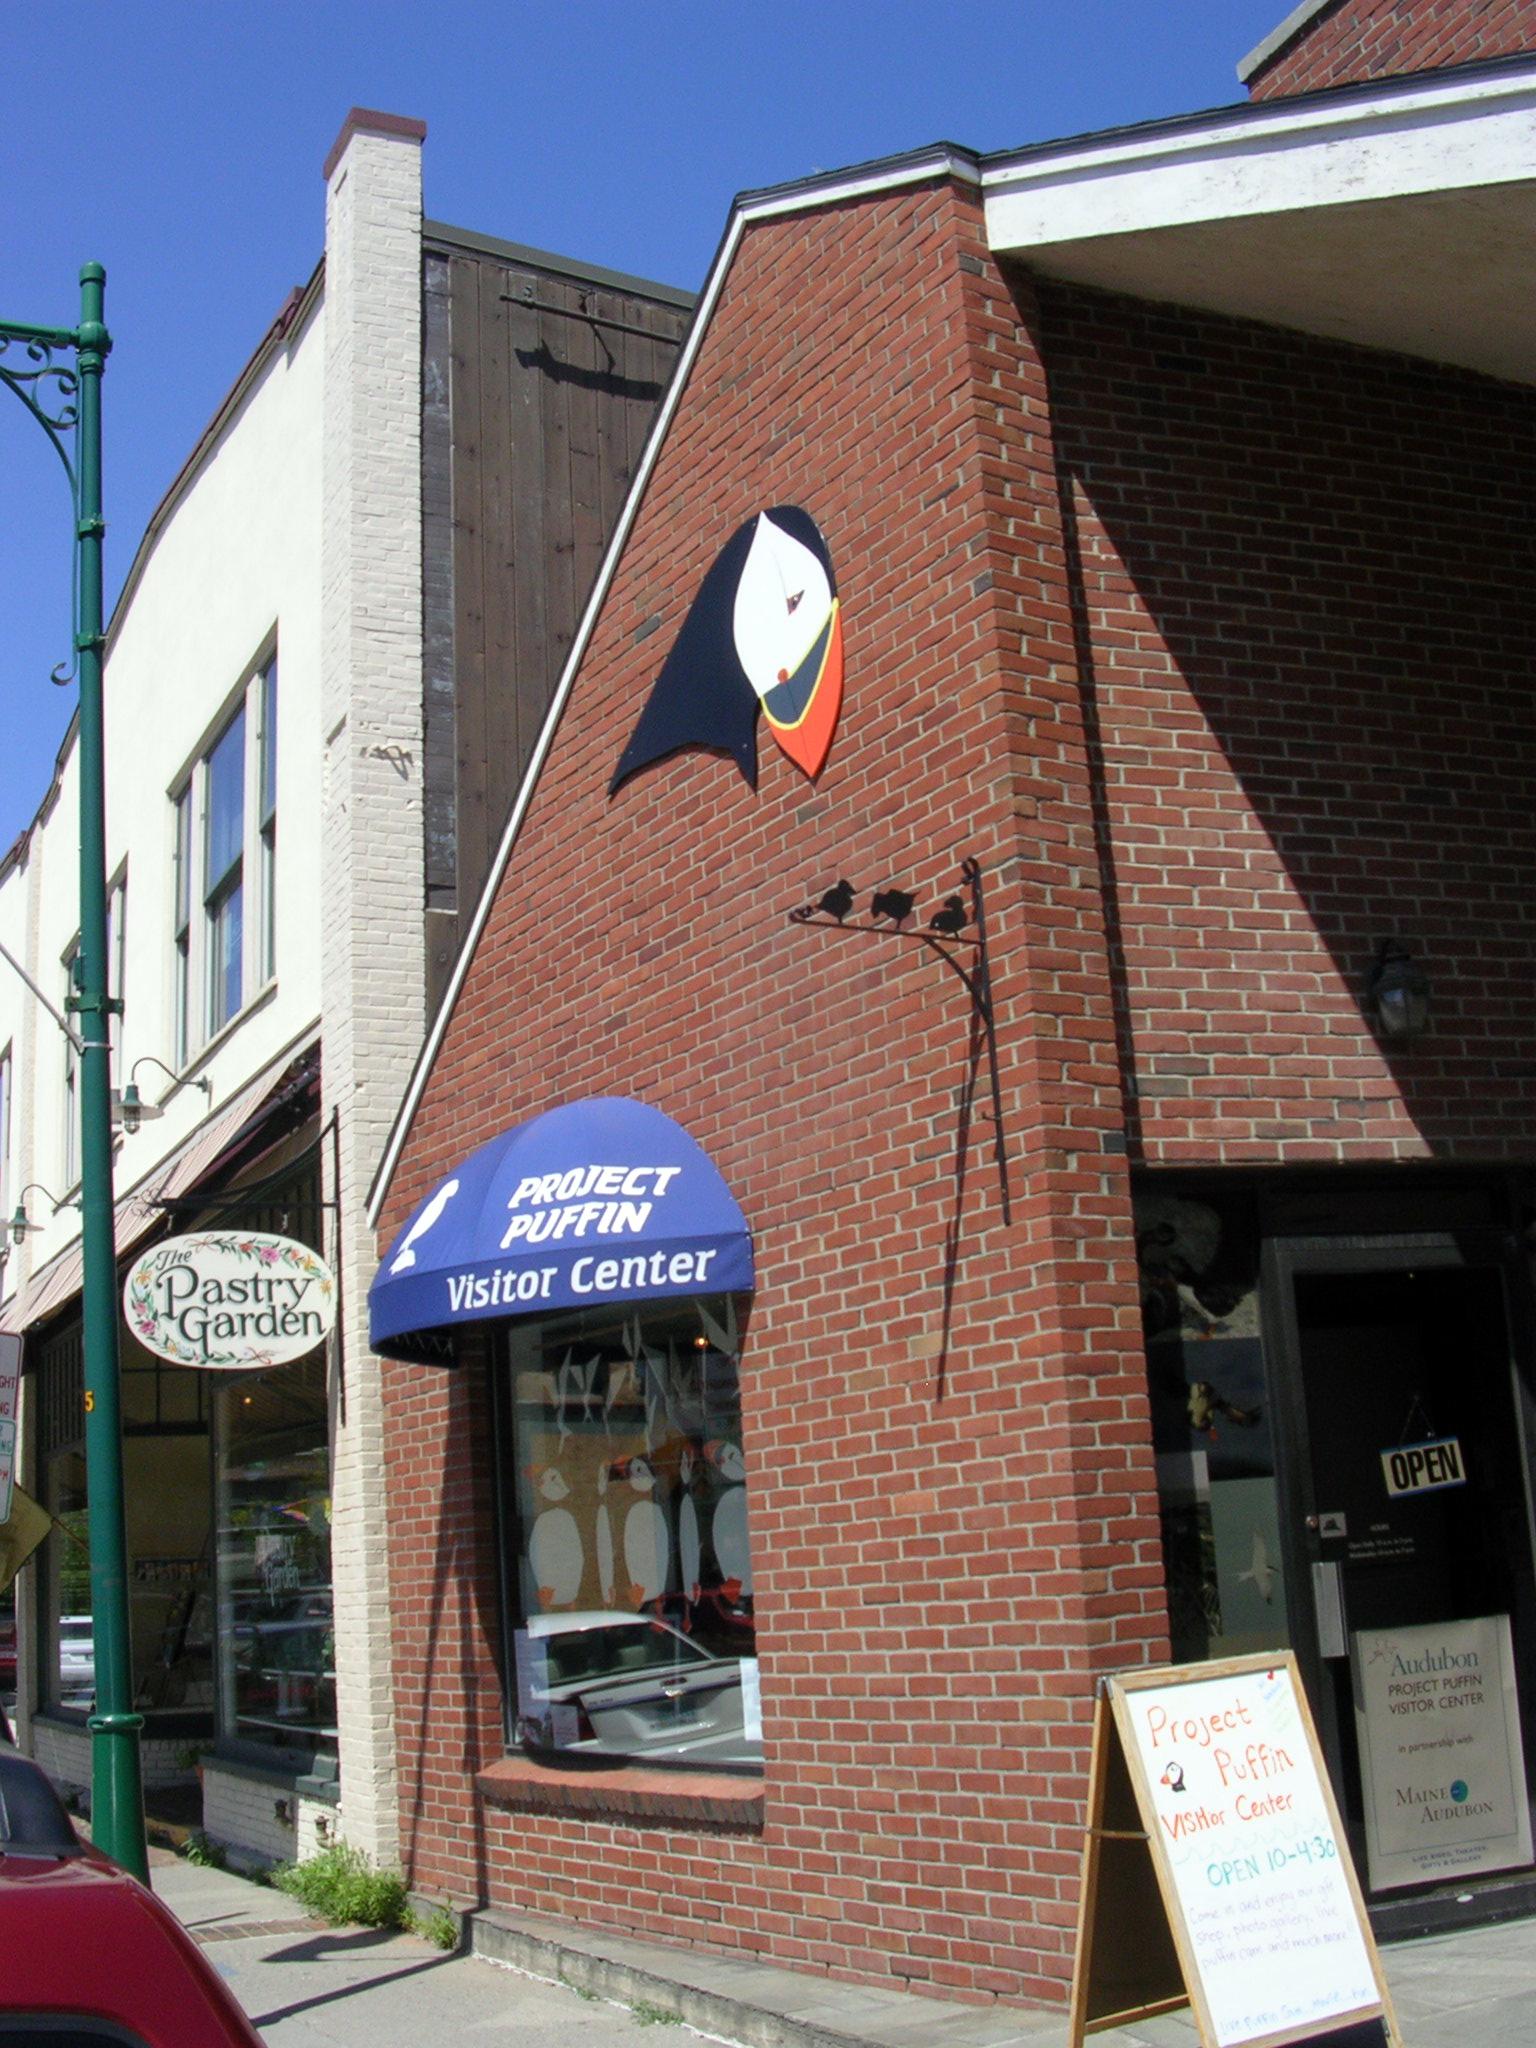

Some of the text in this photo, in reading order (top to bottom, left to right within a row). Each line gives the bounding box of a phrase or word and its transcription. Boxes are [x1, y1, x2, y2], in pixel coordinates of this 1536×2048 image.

[507, 1164, 682, 1209] PROJECT
[499, 1202, 653, 1250] PUFFIN
[155, 1249, 193, 1271] The
[446, 1248, 717, 1312] Visitor Center
[155, 1263, 315, 1321] Pastry
[178, 1305, 326, 1361] Garden
[1390, 1444, 1461, 1490] OPEN
[1391, 1646, 1479, 1678] Audubon
[1387, 1673, 1483, 1698] PROJECT PUFFIN
[1388, 1691, 1485, 1716] VISITOR CENTER
[1146, 1698, 1252, 1748] Project
[1408, 1737, 1453, 1754] partnership
[1454, 1734, 1474, 1746] with
[1213, 1743, 1294, 1787] Puffin
[1235, 1793, 1293, 1821] Center
[1396, 1786, 1448, 1807] MAINE
[1420, 1801, 1494, 1824] AUDUBON
[1206, 1836, 1337, 1887] OPEN 10-4:30
